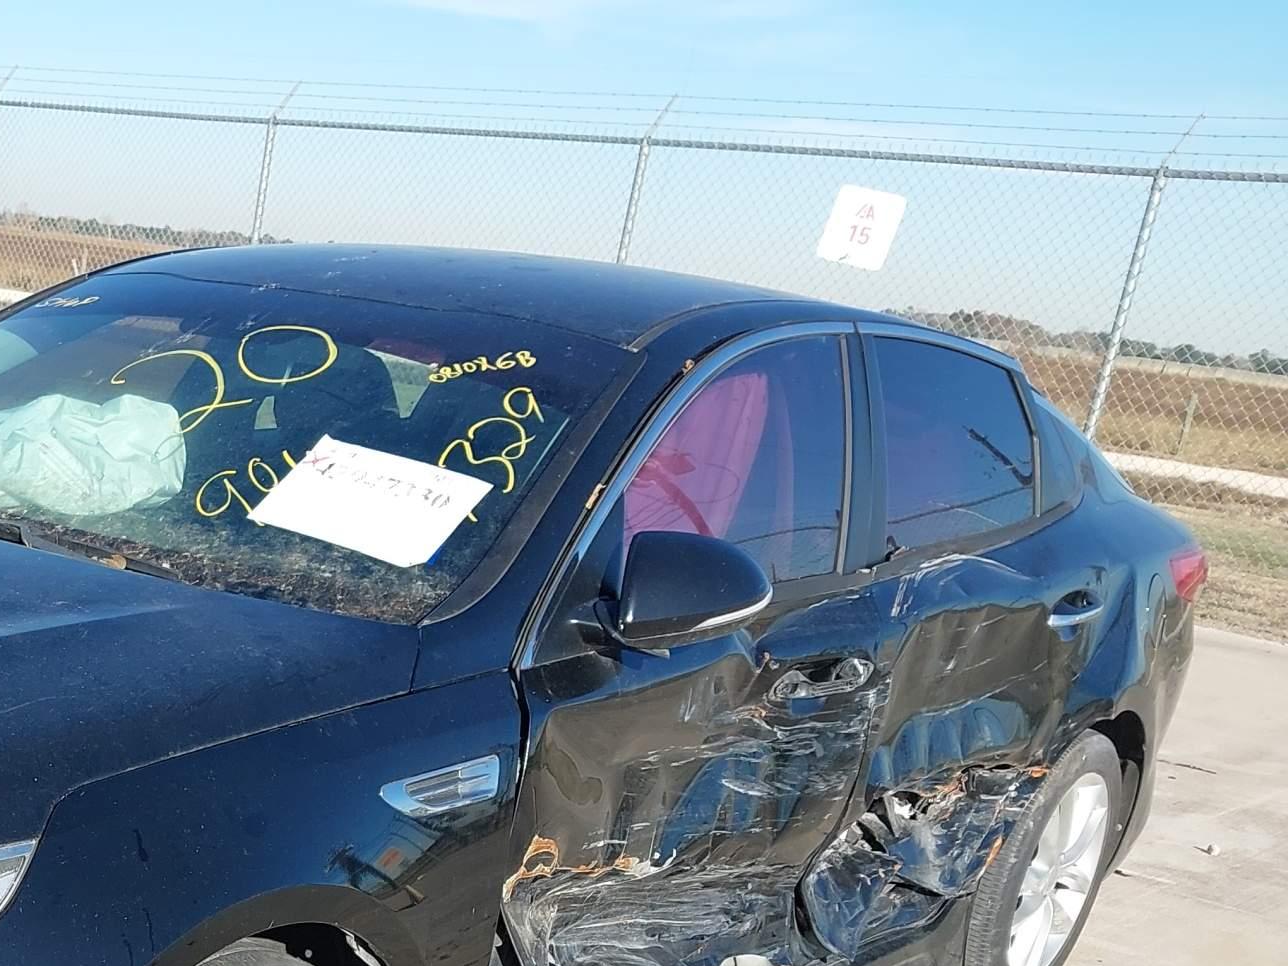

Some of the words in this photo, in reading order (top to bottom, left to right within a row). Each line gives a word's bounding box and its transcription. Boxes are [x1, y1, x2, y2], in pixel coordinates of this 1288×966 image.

[849, 224, 872, 245] 15
[111, 326, 339, 458] 20
[438, 386, 544, 493] 329
